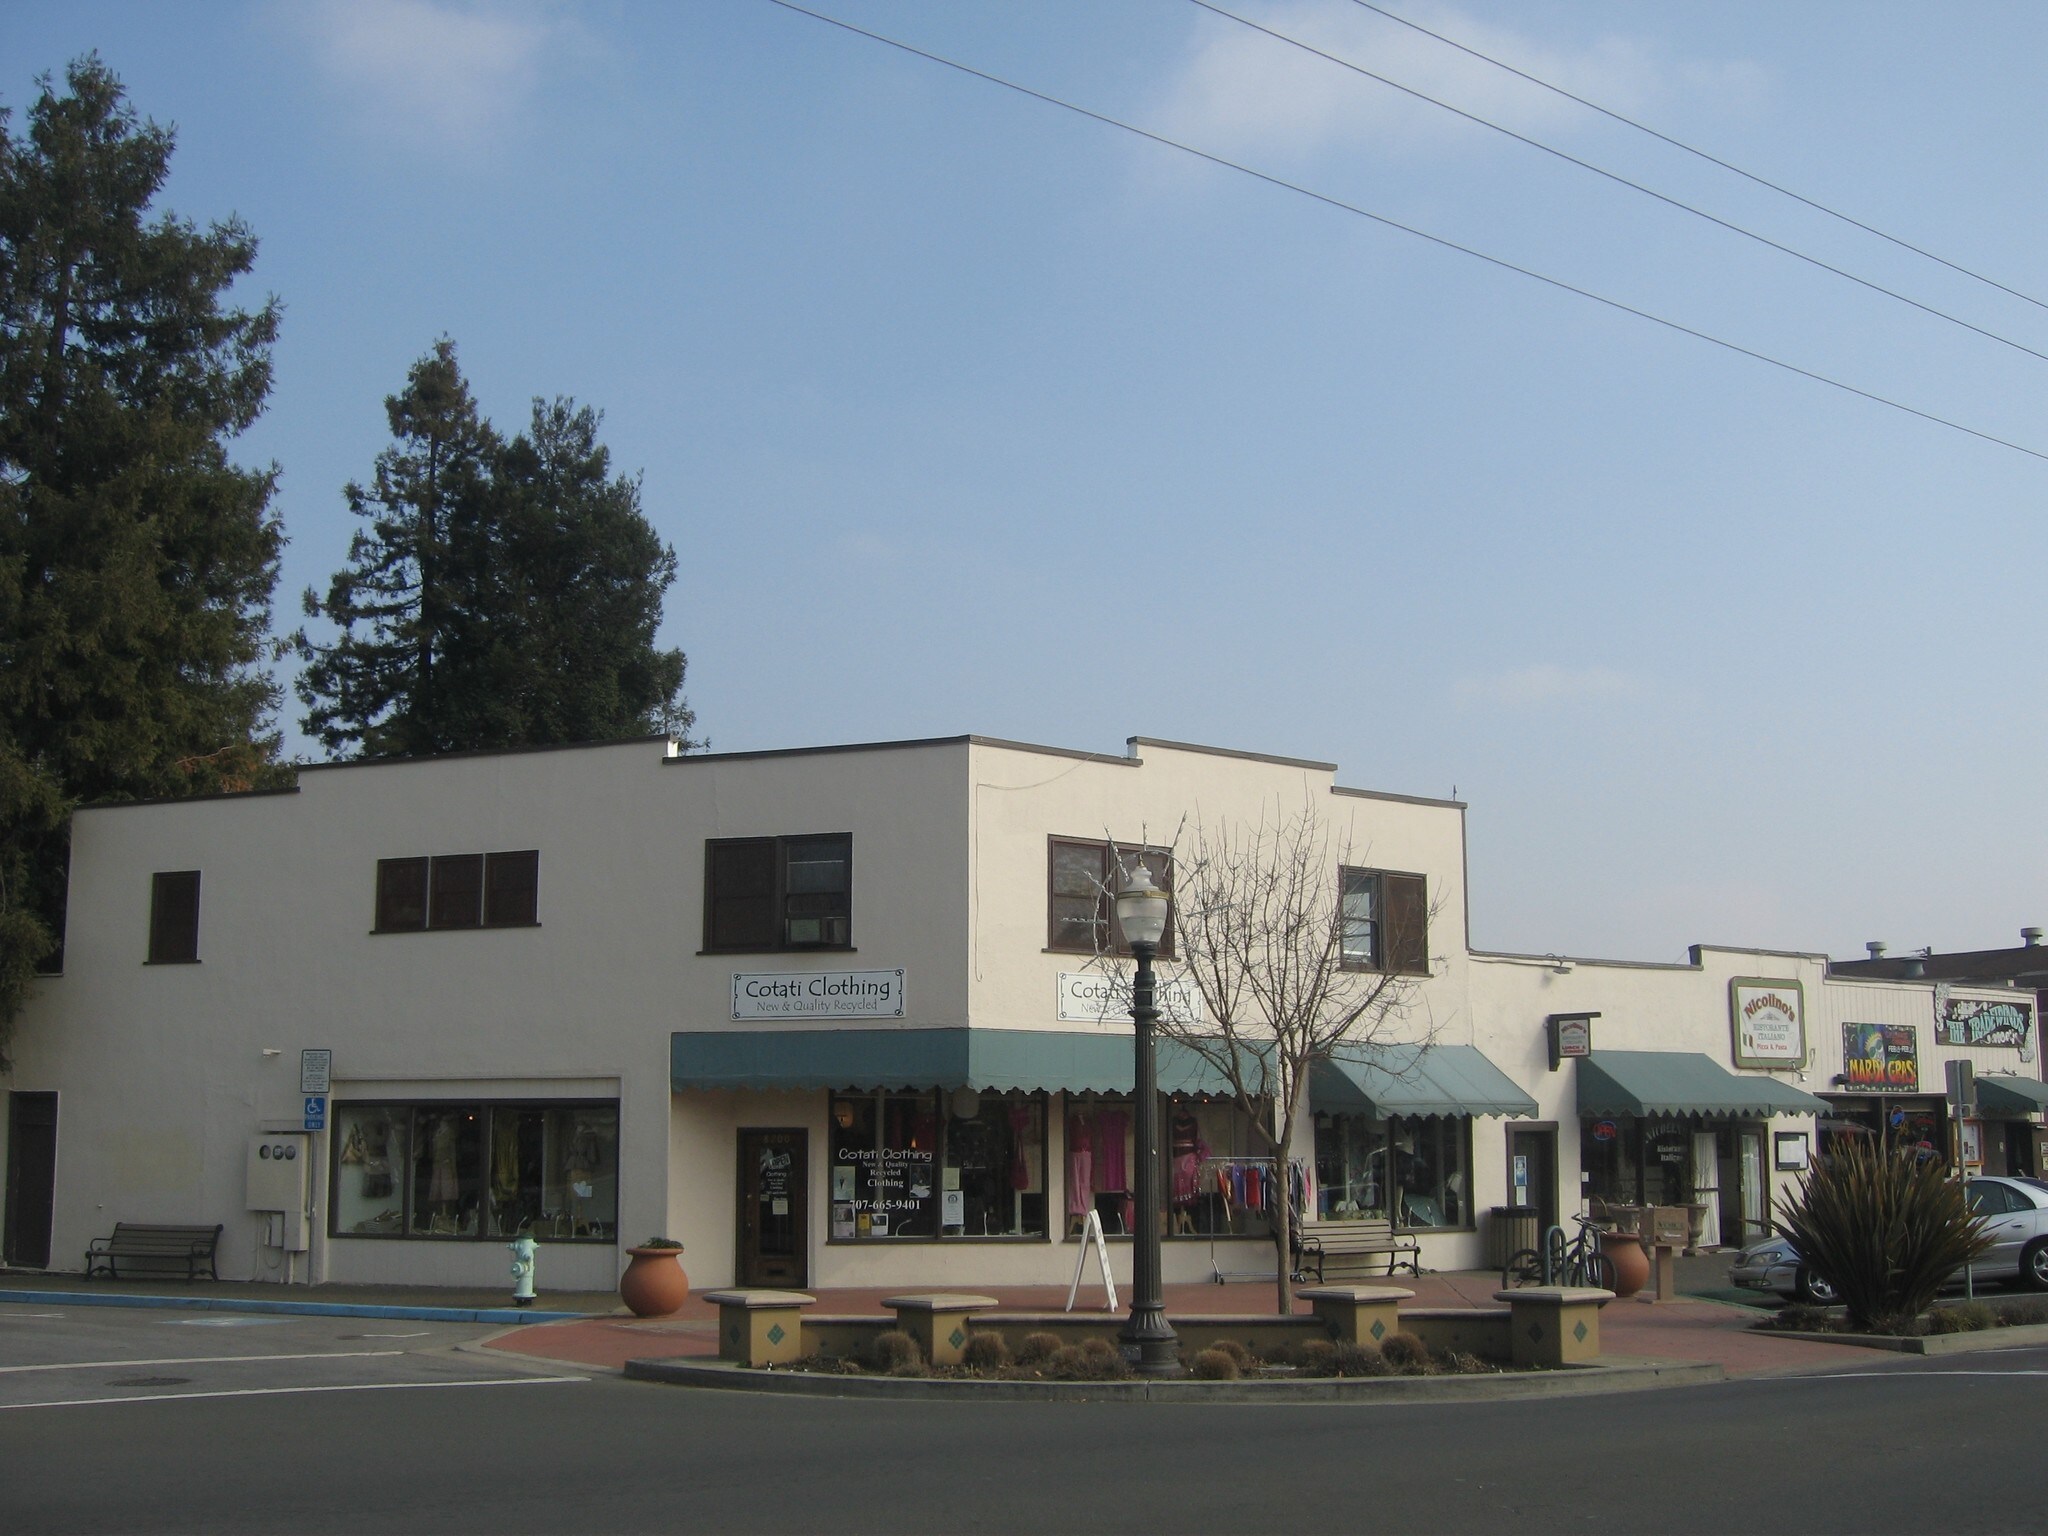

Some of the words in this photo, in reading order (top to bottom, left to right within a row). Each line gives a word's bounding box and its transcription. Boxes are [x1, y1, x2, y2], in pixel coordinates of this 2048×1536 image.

[745, 981, 802, 998] Cotati
[808, 976, 890, 1001] Clothing
[757, 1001, 779, 1012] New
[782, 1001, 790, 1011] &
[793, 999, 831, 1014] Quality
[834, 998, 878, 1013] Recycled
[1744, 993, 1796, 1023] Nicolino's
[1753, 1023, 1790, 1032] RISTORANTE
[1946, 1020, 1966, 1044] THE
[1968, 1004, 2025, 1042] TRADEWINDS
[1758, 1033, 1786, 1041] ITALIANO
[1850, 1058, 1886, 1083] MARDI
[1888, 1060, 1916, 1084] GRAS
[838, 1148, 879, 1160] Cotati
[881, 1148, 933, 1163] Clothing
[870, 1169, 901, 1178] Recycled
[867, 1179, 904, 1189] Clothing
[849, 1200, 921, 1210] 707-665-9401
